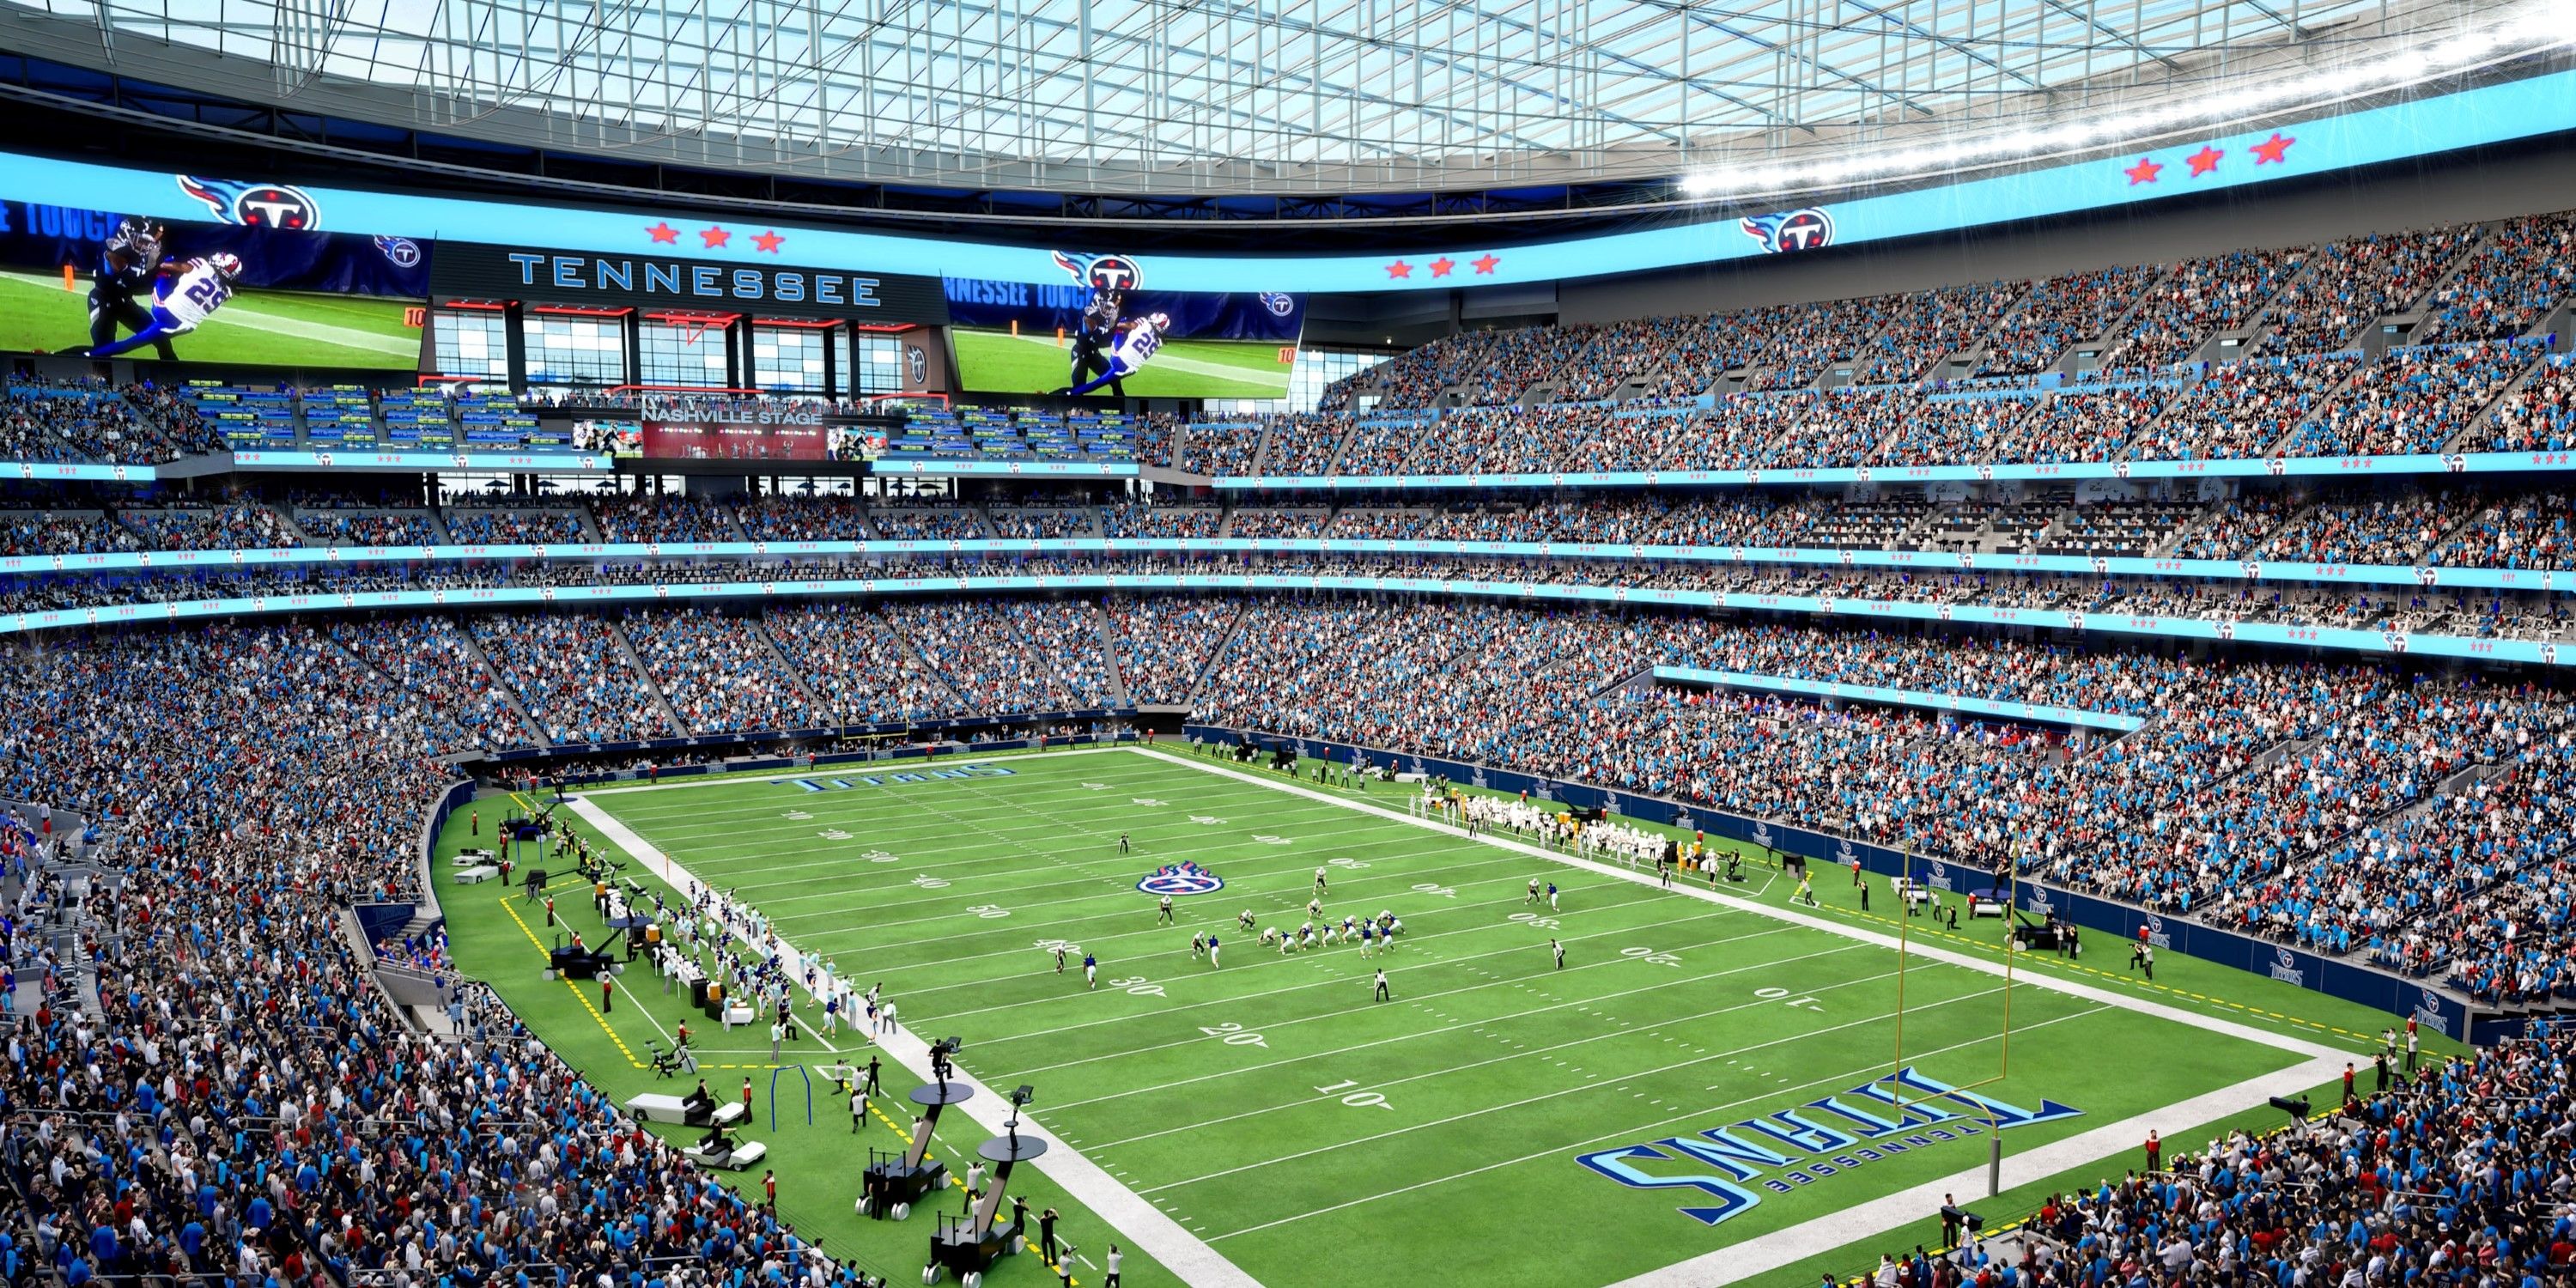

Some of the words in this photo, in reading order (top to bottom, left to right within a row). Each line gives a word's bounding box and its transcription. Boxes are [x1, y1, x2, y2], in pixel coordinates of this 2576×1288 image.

[509, 253, 881, 307] TENNESSEE
[184, 277, 226, 314] 29
[407, 309, 425, 326] 10
[1280, 349, 1294, 361] 10
[641, 409, 753, 424] NASHVILLE
[758, 412, 823, 426] STAGE
[966, 904, 1012, 919] 50
[1508, 913, 1560, 927] 30
[1619, 946, 1682, 964] 20
[1109, 976, 1164, 995] 30
[1754, 987, 1821, 1007] 10
[1198, 1023, 1264, 1046] 20
[1313, 1079, 1386, 1107] 10
[1575, 1066, 2087, 1226] TITANS
[1763, 1124, 1982, 1194] TENNESSEE
